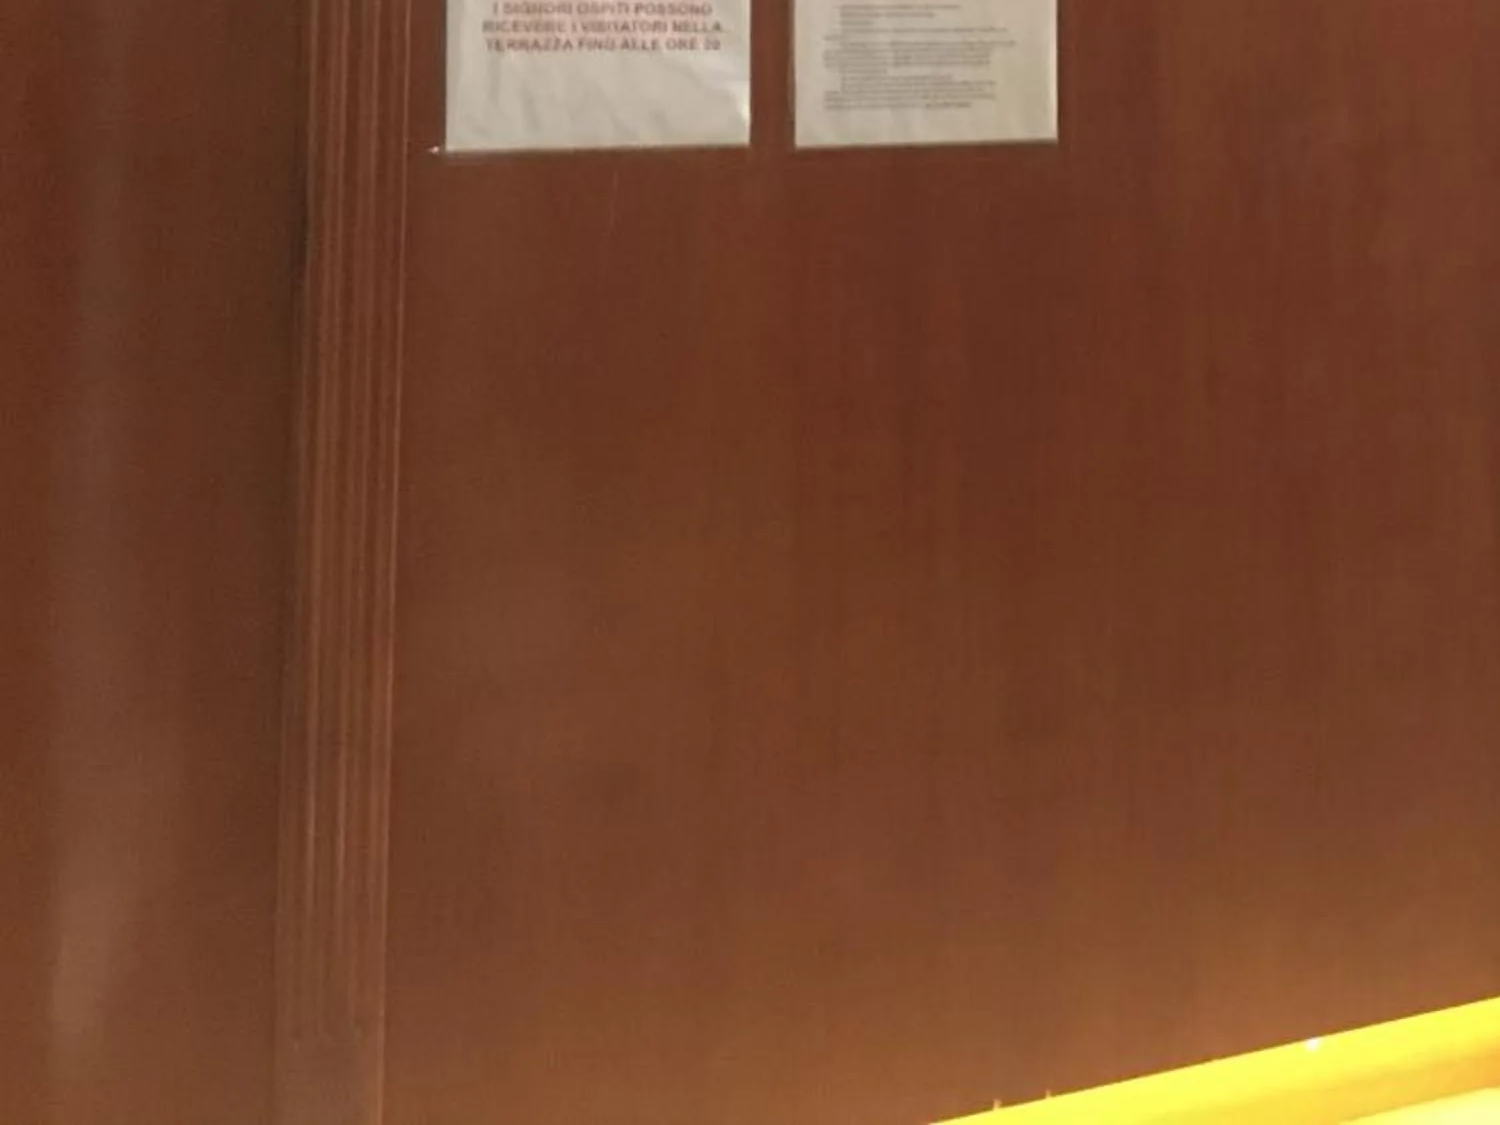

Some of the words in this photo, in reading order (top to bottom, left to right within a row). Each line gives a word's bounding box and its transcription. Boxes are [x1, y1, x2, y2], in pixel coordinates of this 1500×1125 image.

[503, 2, 572, 15] SIGNORI
[576, 3, 629, 15] OSPITI
[634, 3, 713, 16] POSSONO
[482, 20, 568, 33] RICEVERE
[581, 20, 668, 33] VISITATORI
[672, 20, 722, 33] NELLA
[485, 37, 573, 51] TERRAZZA
[578, 38, 616, 51] FINO
[620, 38, 659, 51] ALLE
[665, 38, 697, 51] ORE
